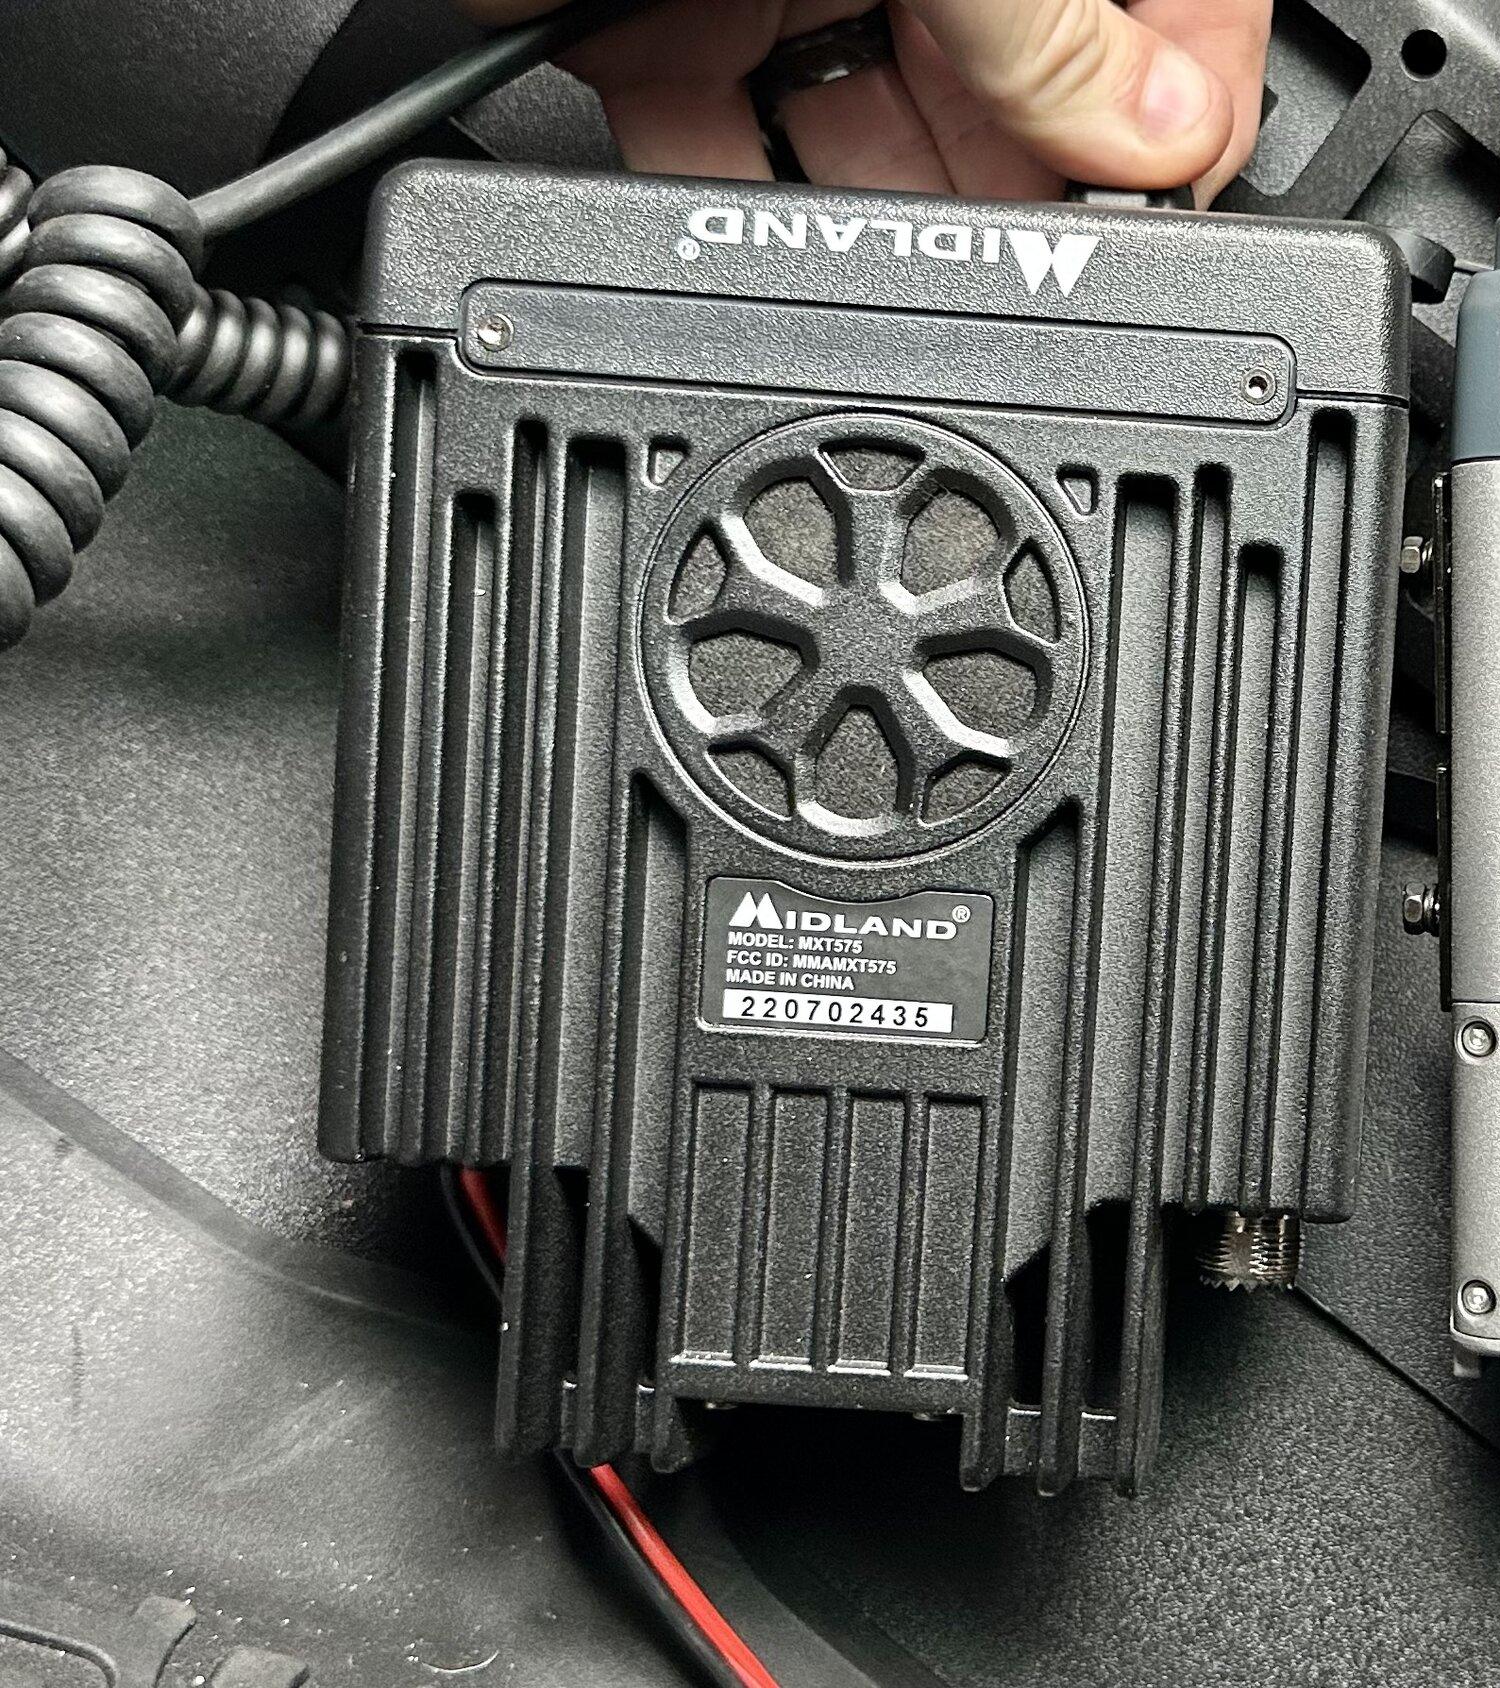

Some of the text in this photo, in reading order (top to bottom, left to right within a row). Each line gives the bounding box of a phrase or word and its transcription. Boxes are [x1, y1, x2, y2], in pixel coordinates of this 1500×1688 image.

[727, 931, 863, 954] MODEL: MXT575
[726, 952, 897, 974] FCC ID: MMAMXT575
[726, 968, 855, 990] MADE IN CHINA
[741, 996, 929, 1027] 220702435
